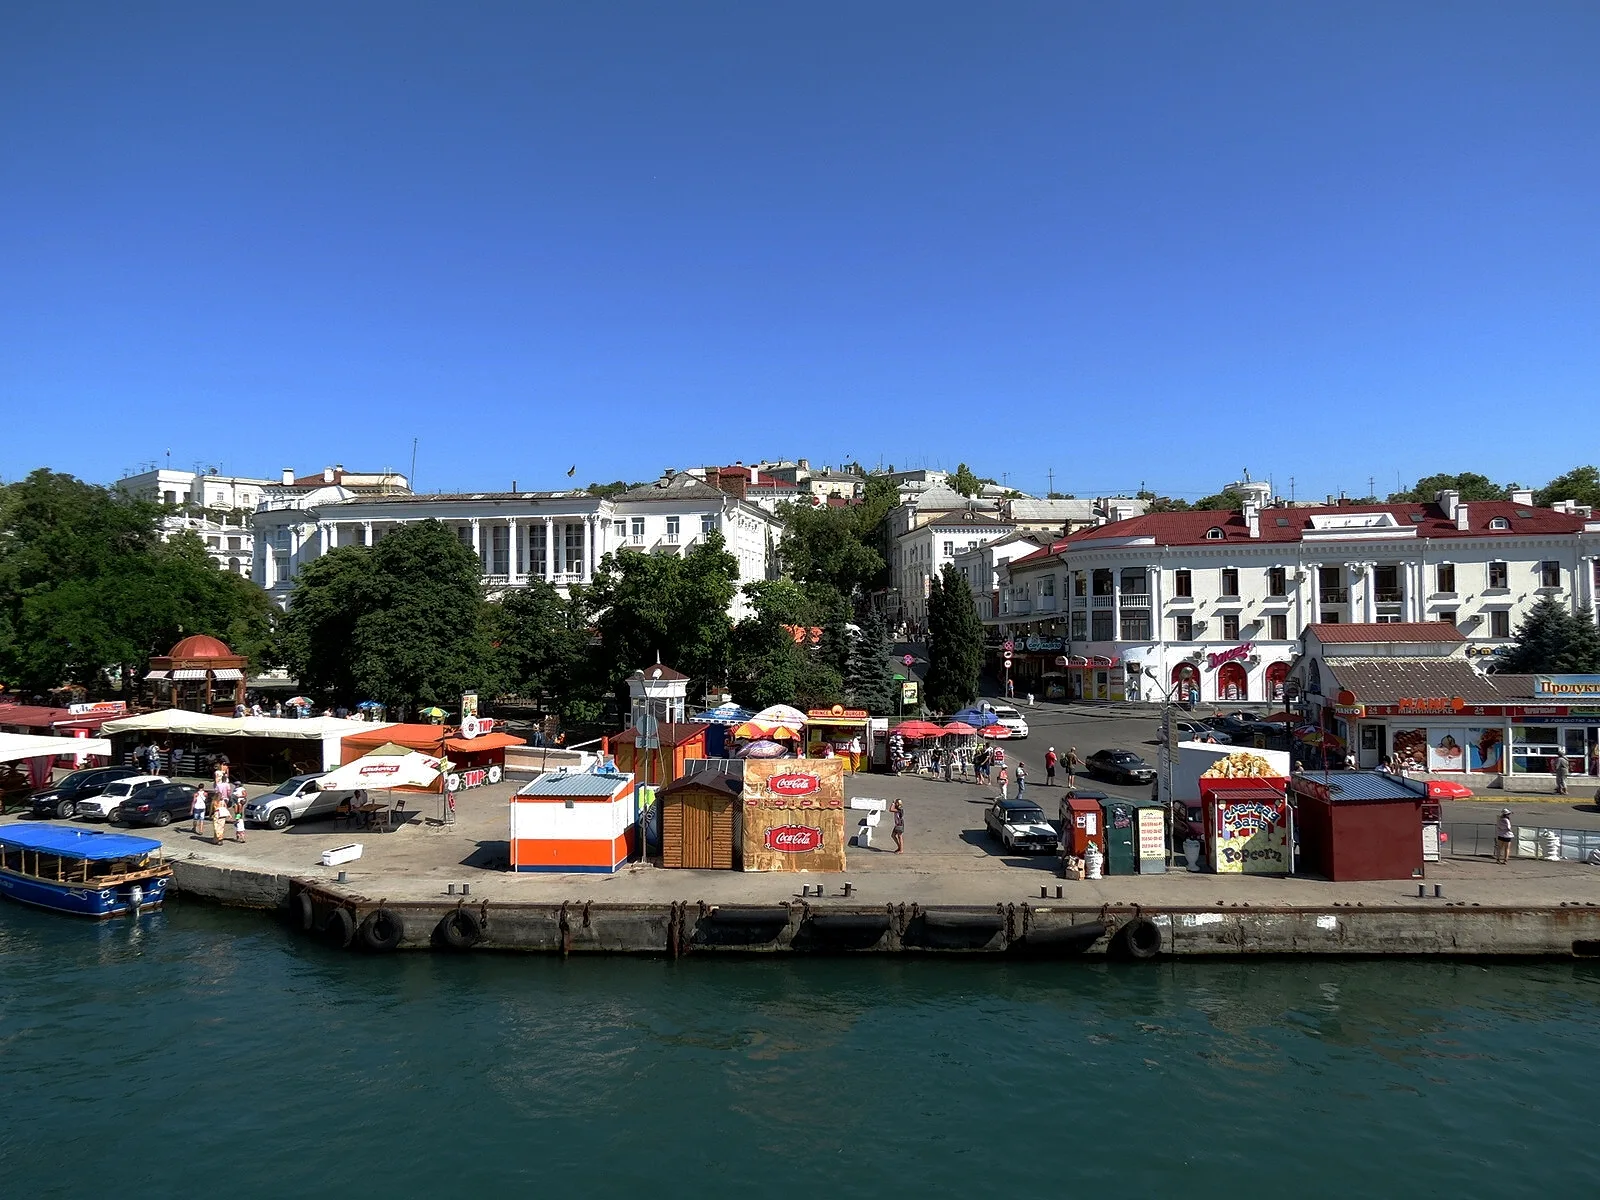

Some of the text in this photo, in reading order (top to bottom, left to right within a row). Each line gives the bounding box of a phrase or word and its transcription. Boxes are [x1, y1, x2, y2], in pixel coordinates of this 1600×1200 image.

[478, 719, 493, 733] ТИР
[465, 770, 486, 786] ТИР
[1222, 847, 1282, 863] Popcorn
